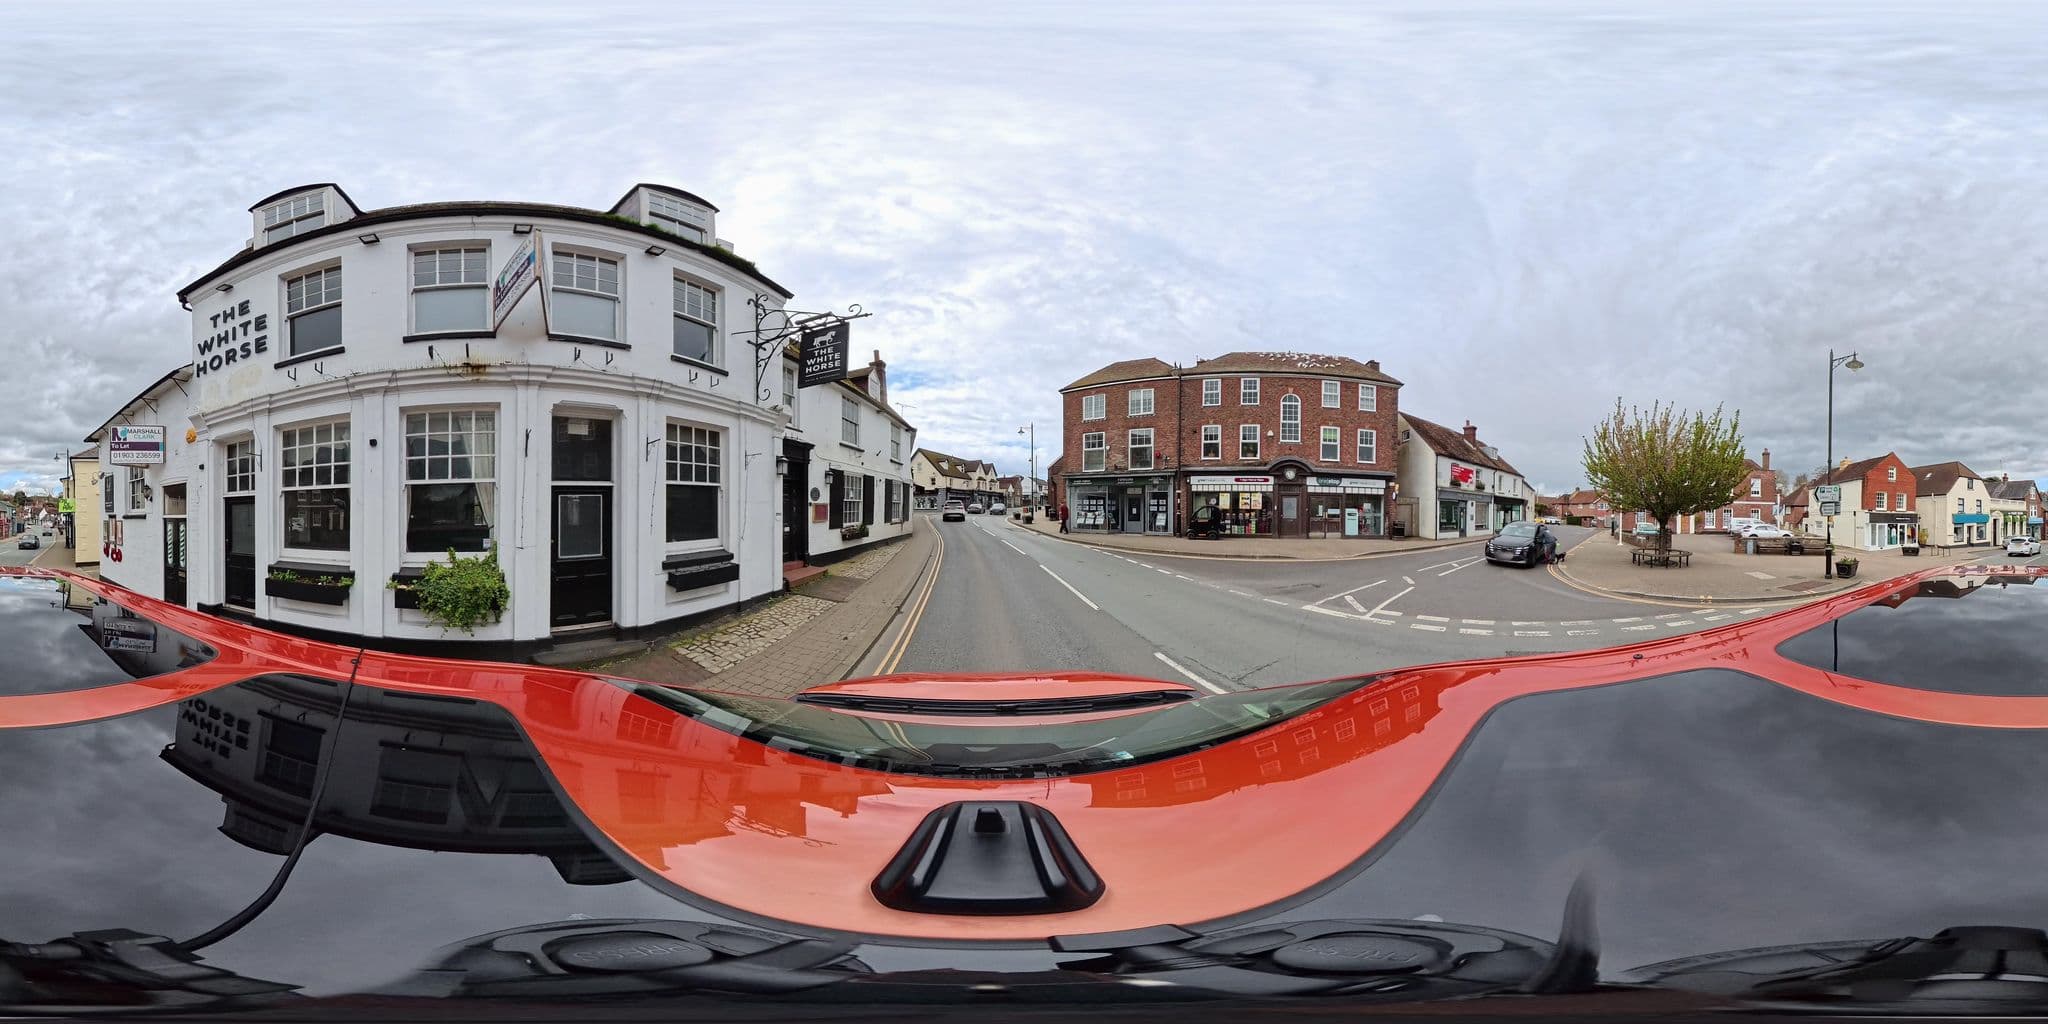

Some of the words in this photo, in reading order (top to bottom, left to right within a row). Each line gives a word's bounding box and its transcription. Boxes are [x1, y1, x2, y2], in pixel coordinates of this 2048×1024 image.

[210, 299, 250, 328] THE
[198, 314, 267, 355] WHITE
[197, 335, 267, 378] HORSE
[807, 353, 841, 365] WHITE
[814, 347, 834, 356] THE
[806, 360, 841, 373] HORSE
